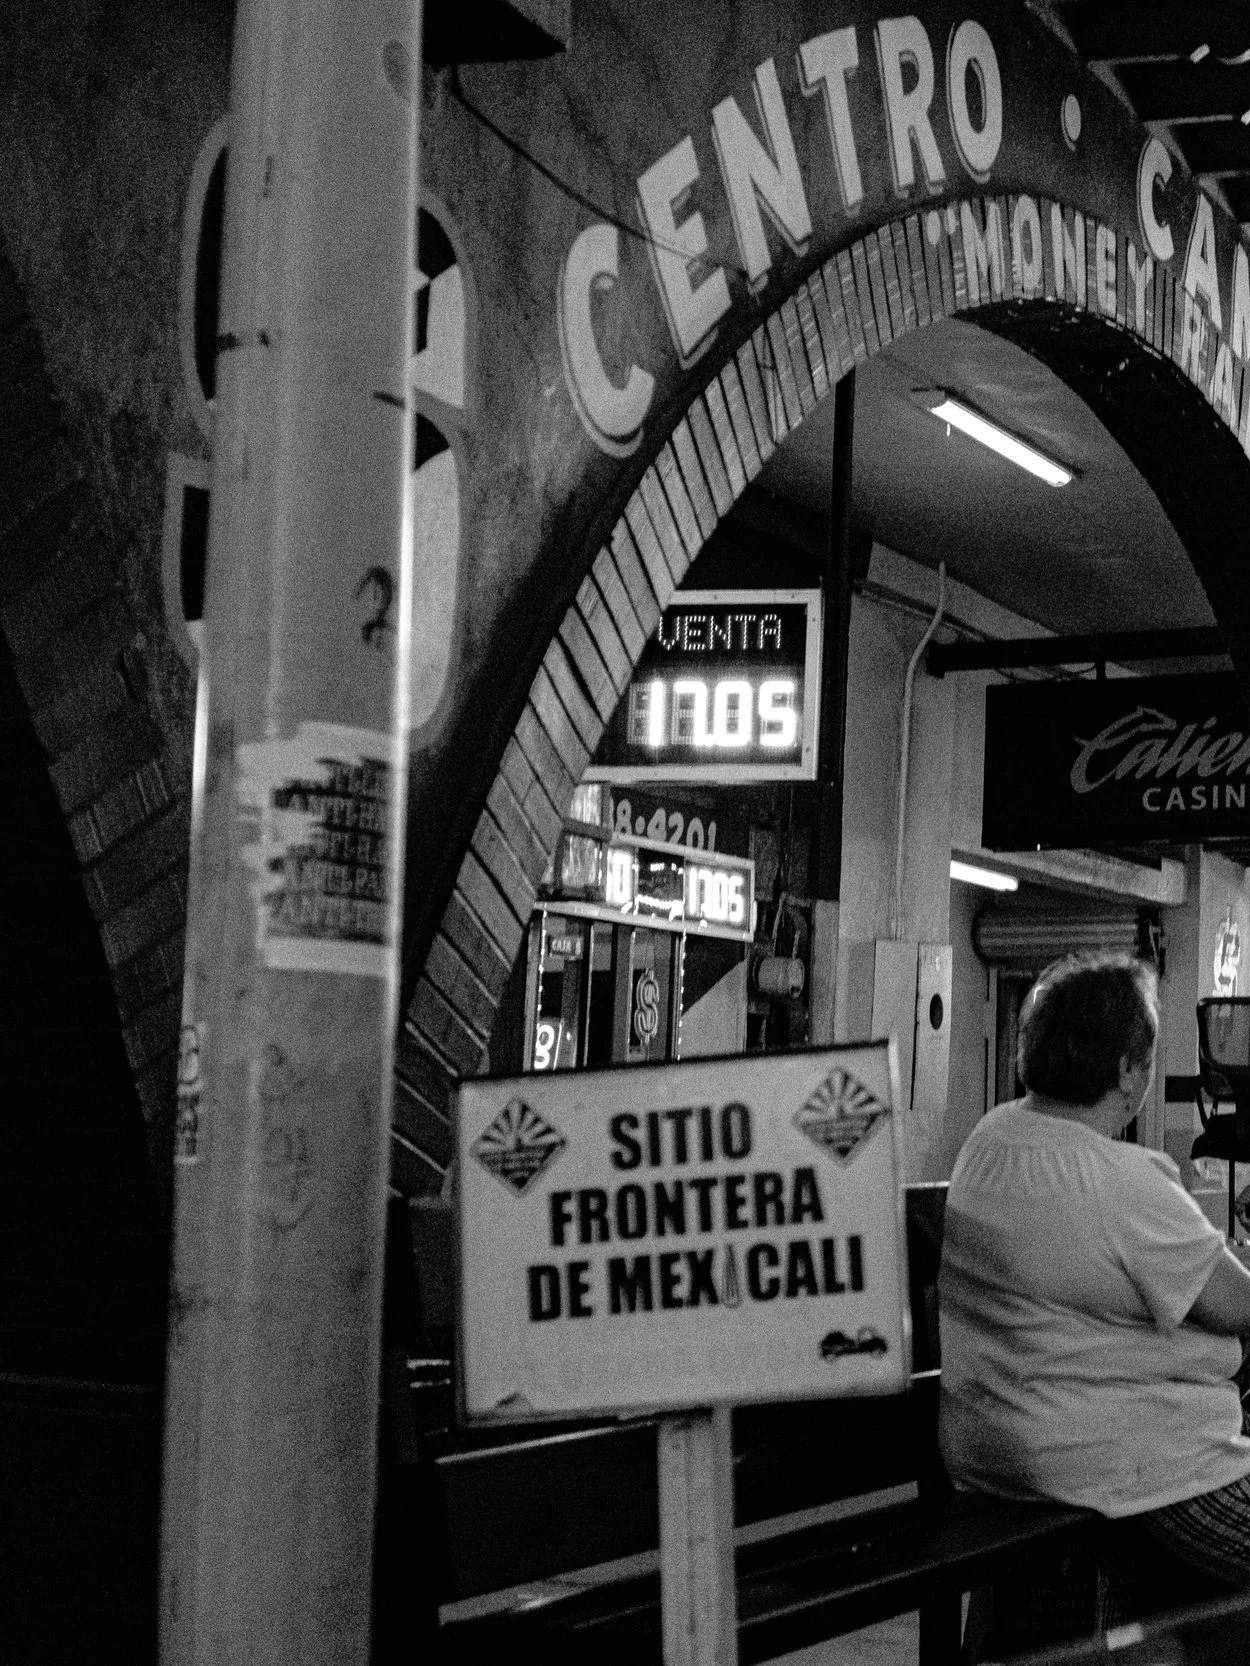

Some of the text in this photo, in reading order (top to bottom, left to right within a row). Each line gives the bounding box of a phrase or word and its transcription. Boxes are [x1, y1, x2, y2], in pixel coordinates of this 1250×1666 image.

[557, 15, 1003, 445] CENTRO
[658, 613, 782, 650] VENTA
[609, 1102, 752, 1171] SITIO
[548, 1166, 824, 1247] FRONTERA
[527, 1234, 865, 1322] DE MEXICALI
